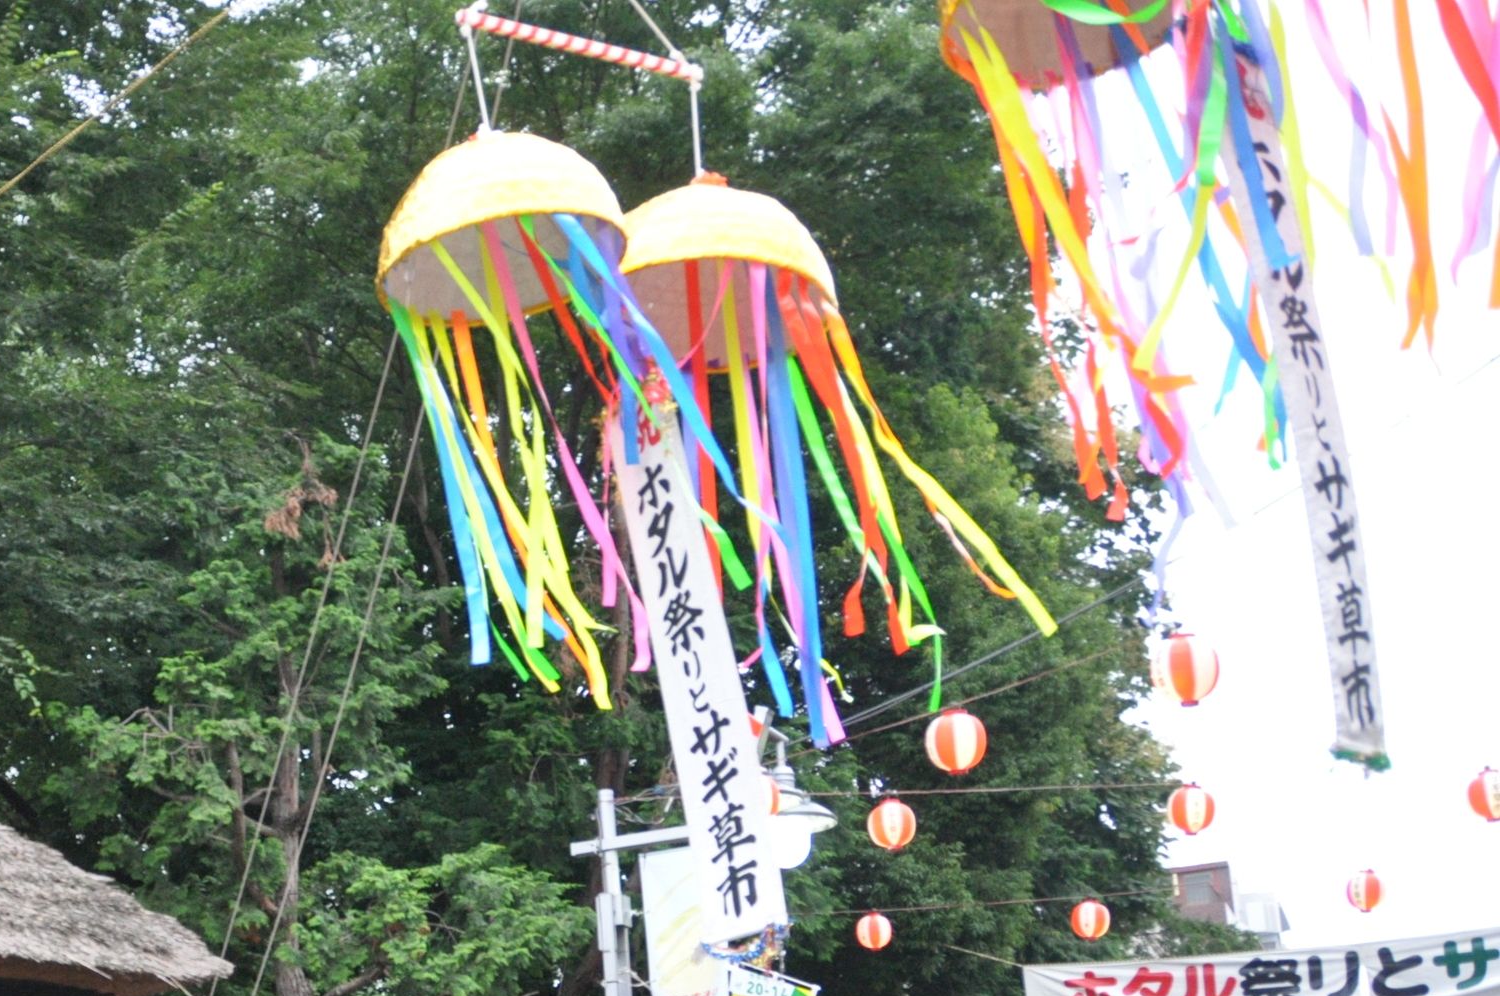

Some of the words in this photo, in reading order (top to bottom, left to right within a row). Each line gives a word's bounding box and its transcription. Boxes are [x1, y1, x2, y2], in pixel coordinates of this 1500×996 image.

[638, 463, 757, 918] ホタル祭りとサギ草市
